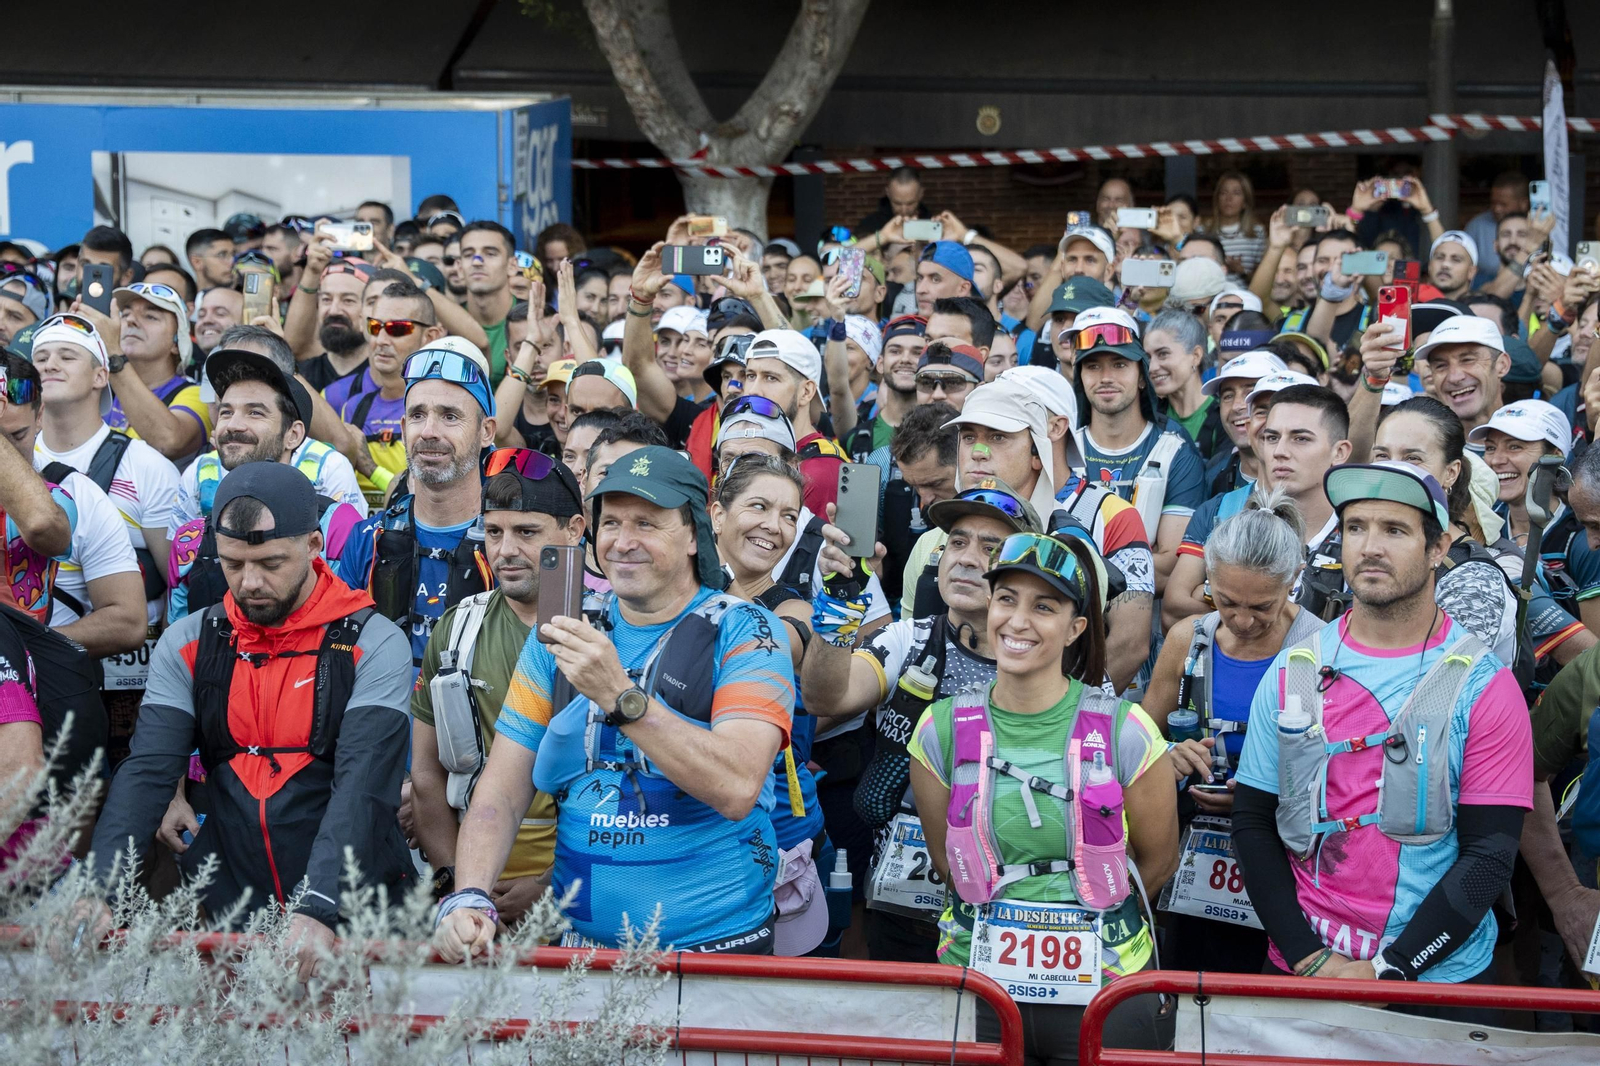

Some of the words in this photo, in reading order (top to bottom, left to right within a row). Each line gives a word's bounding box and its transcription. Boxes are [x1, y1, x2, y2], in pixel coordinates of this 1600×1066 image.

[662, 672, 687, 690] EVADICT
[880, 721, 911, 745] MAX
[590, 811, 669, 828] muebles
[1205, 837, 1217, 849] LA
[954, 846, 969, 883] AONIJIE
[1102, 863, 1117, 897] AONIJIE
[998, 906, 1012, 920] LA
[1204, 905, 1238, 919] asisa
[998, 931, 1082, 970] 2198
[1411, 932, 1451, 969] KIPRUN
[1040, 974, 1077, 982] CABECILLA
[1008, 984, 1047, 998] asisa
